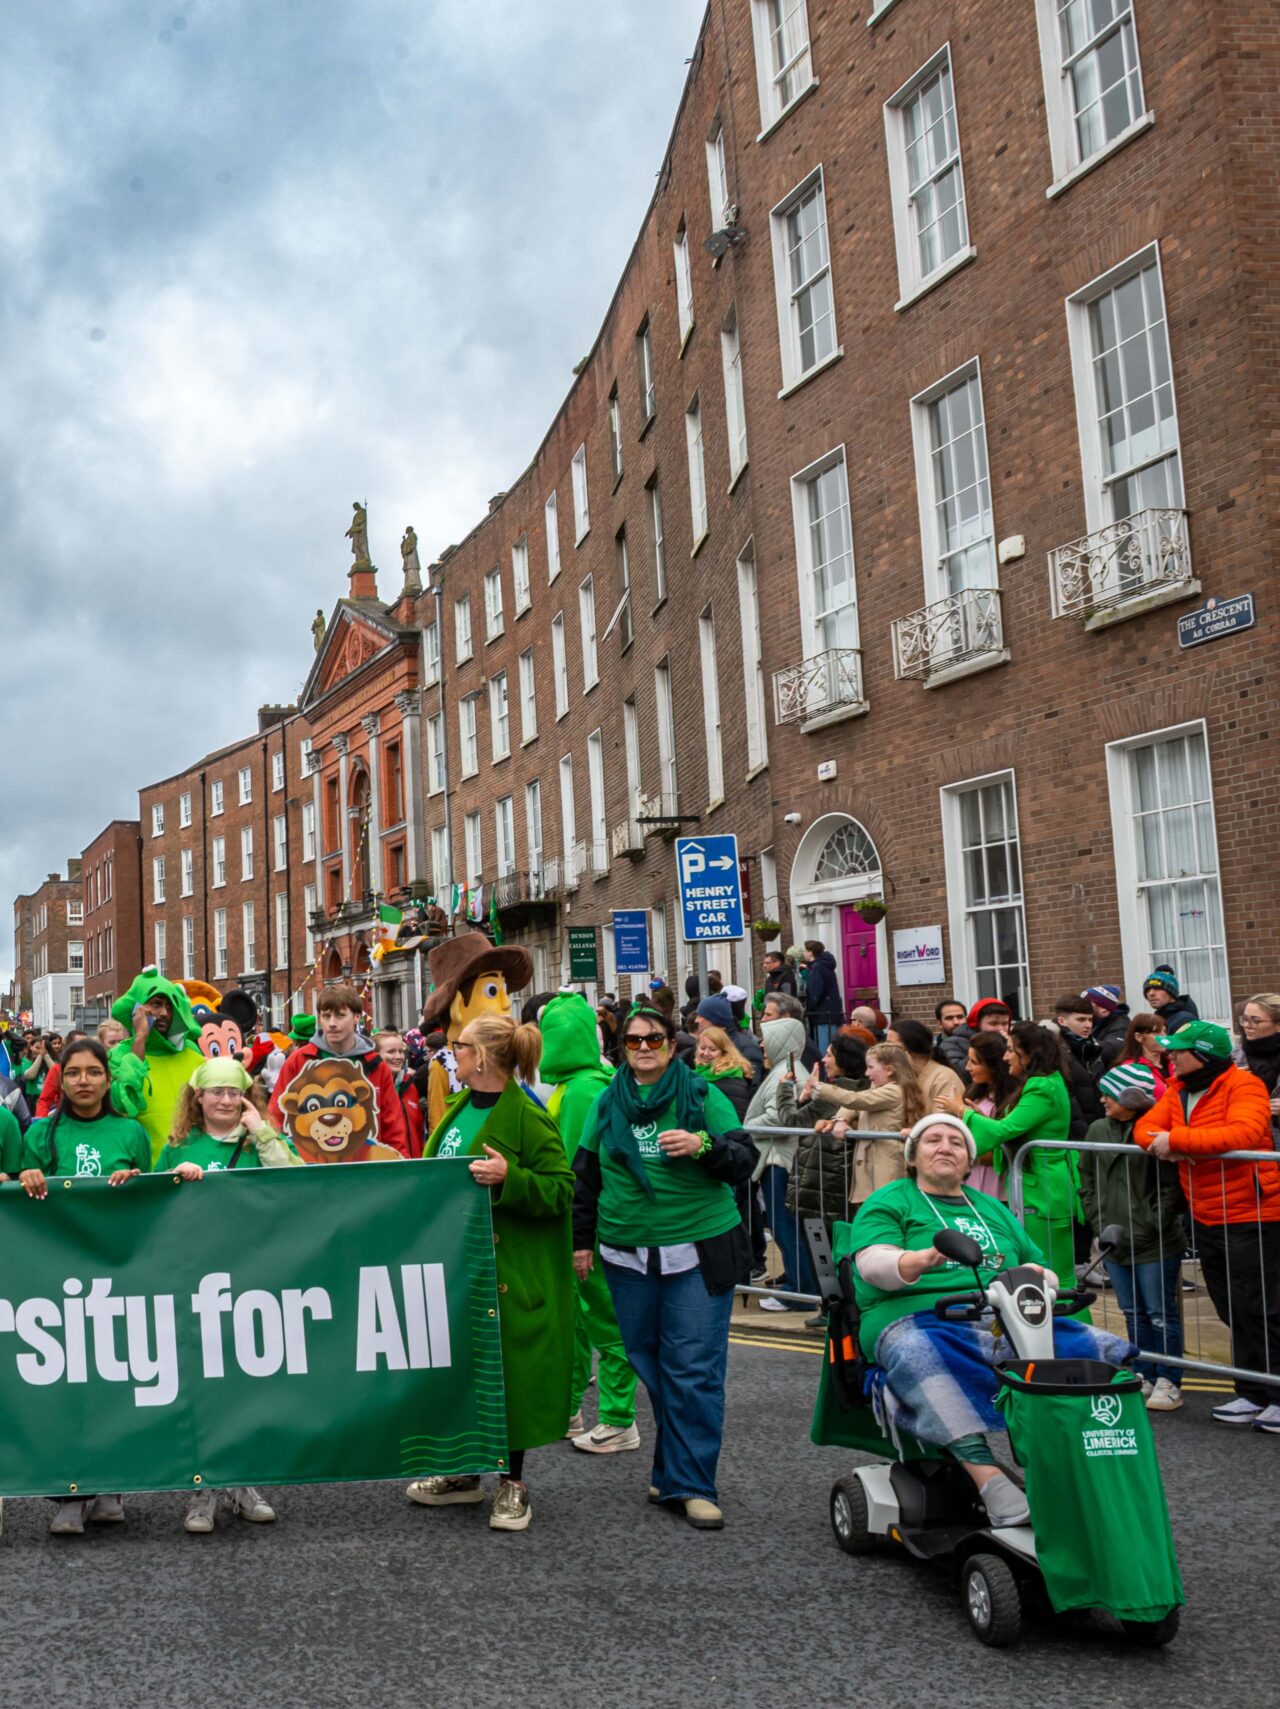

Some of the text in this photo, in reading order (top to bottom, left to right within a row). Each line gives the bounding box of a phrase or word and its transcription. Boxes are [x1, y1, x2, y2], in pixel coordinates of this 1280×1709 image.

[1180, 600, 1250, 632] THE CRESCENT
[682, 853, 706, 883] P
[685, 885, 734, 898] HENRY
[686, 898, 737, 911] STREET
[699, 912, 727, 924] CAR
[696, 925, 732, 936] PARK
[191, 1272, 332, 1379] for
[355, 1263, 453, 1372] All
[1082, 1428, 1136, 1439] UNIVERSITY OF
[1083, 1437, 1137, 1450] LIMERICK
